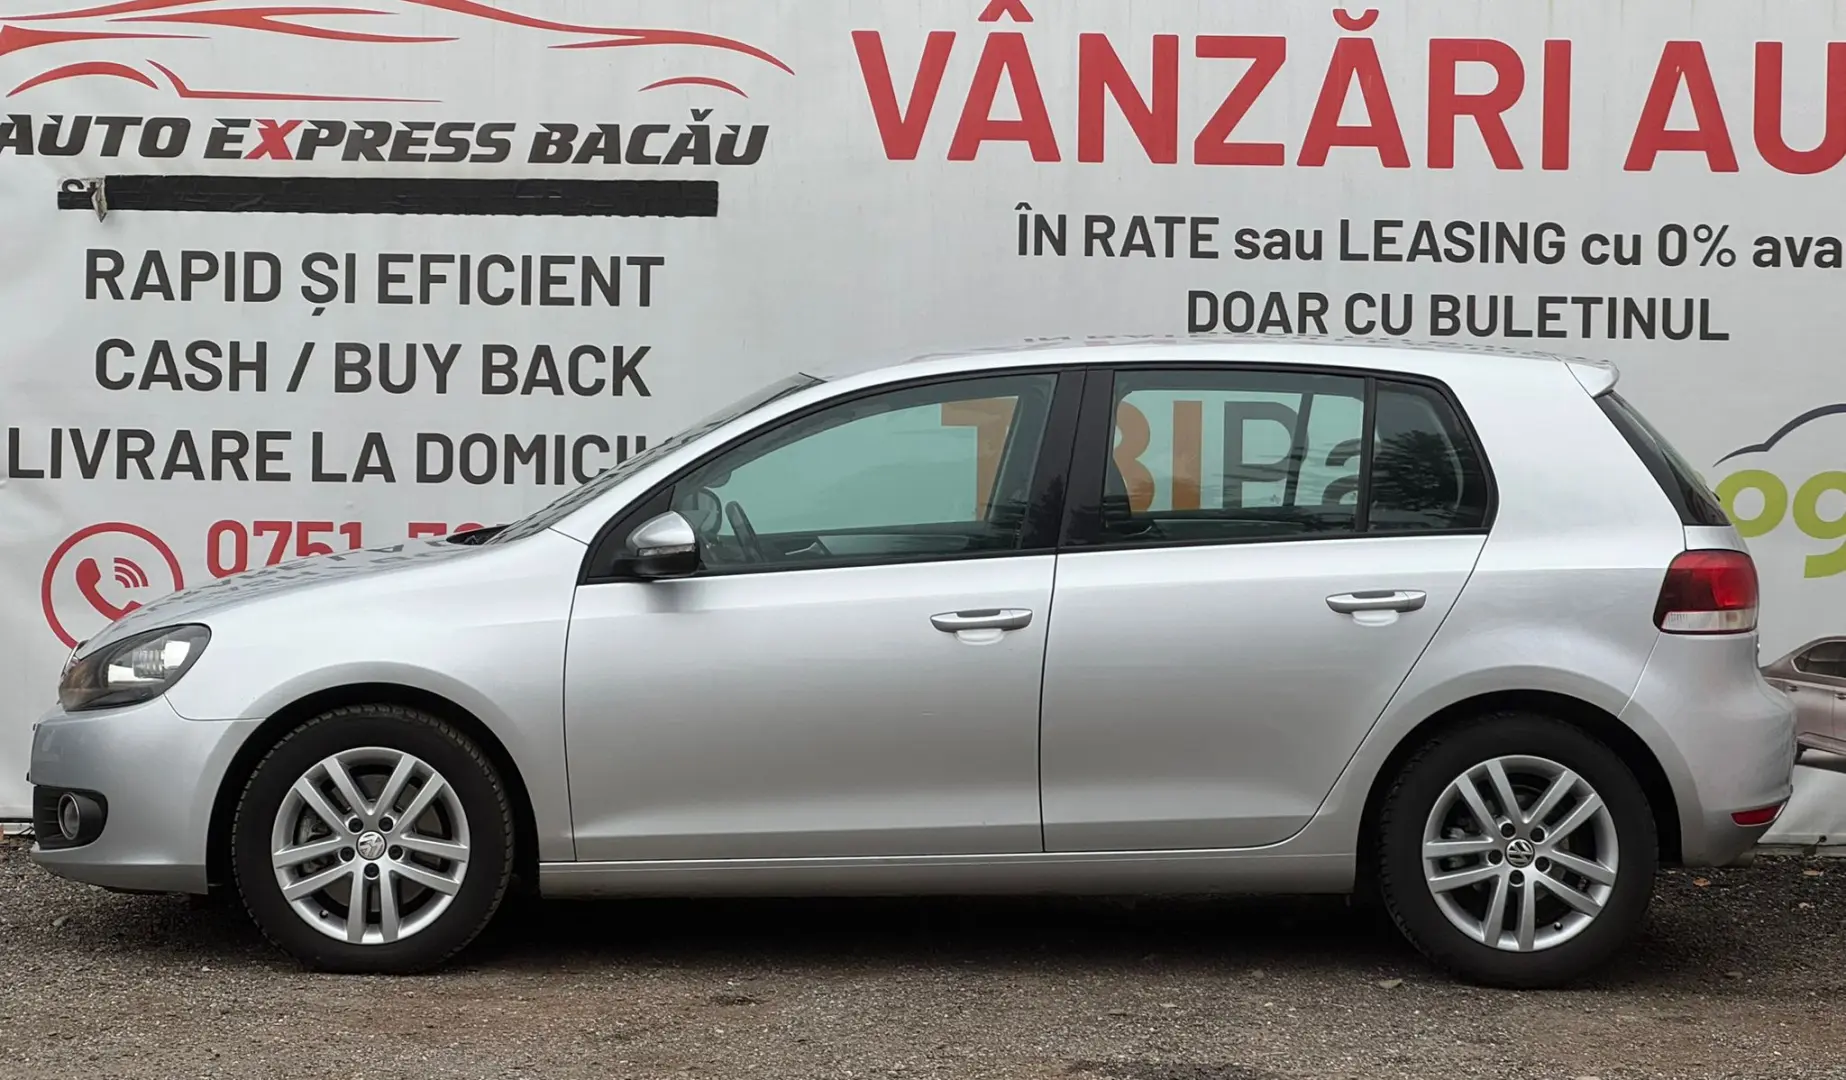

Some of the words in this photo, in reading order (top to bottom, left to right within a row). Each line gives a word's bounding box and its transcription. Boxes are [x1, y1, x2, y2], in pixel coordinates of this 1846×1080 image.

[851, 0, 1572, 171] VÂNZĂRI
[1623, 40, 1846, 174] AU
[0, 114, 190, 158] AUTO
[203, 118, 517, 163] EXPRESS
[527, 108, 770, 166] BACĂU
[1014, 202, 1067, 257] ÎN
[1084, 214, 1221, 260] RATE
[1234, 228, 1323, 261] sau
[1339, 218, 1566, 265] LEASING
[1581, 233, 1642, 267] cu
[1658, 223, 1737, 268] 0%
[1752, 235, 1843, 269] ava
[85, 248, 282, 303] RAPID
[300, 251, 356, 317] ȘI
[377, 253, 665, 308] EFICIENT
[1187, 290, 1329, 335] DOAR
[1344, 292, 1413, 337] CU
[1429, 294, 1730, 341] BULETINUL
[95, 338, 268, 392] CASH
[286, 341, 316, 393] /
[334, 342, 462, 395] BUY
[480, 344, 652, 397] BACK
[8, 427, 292, 483] LIVRARE
[311, 431, 397, 483] LA
